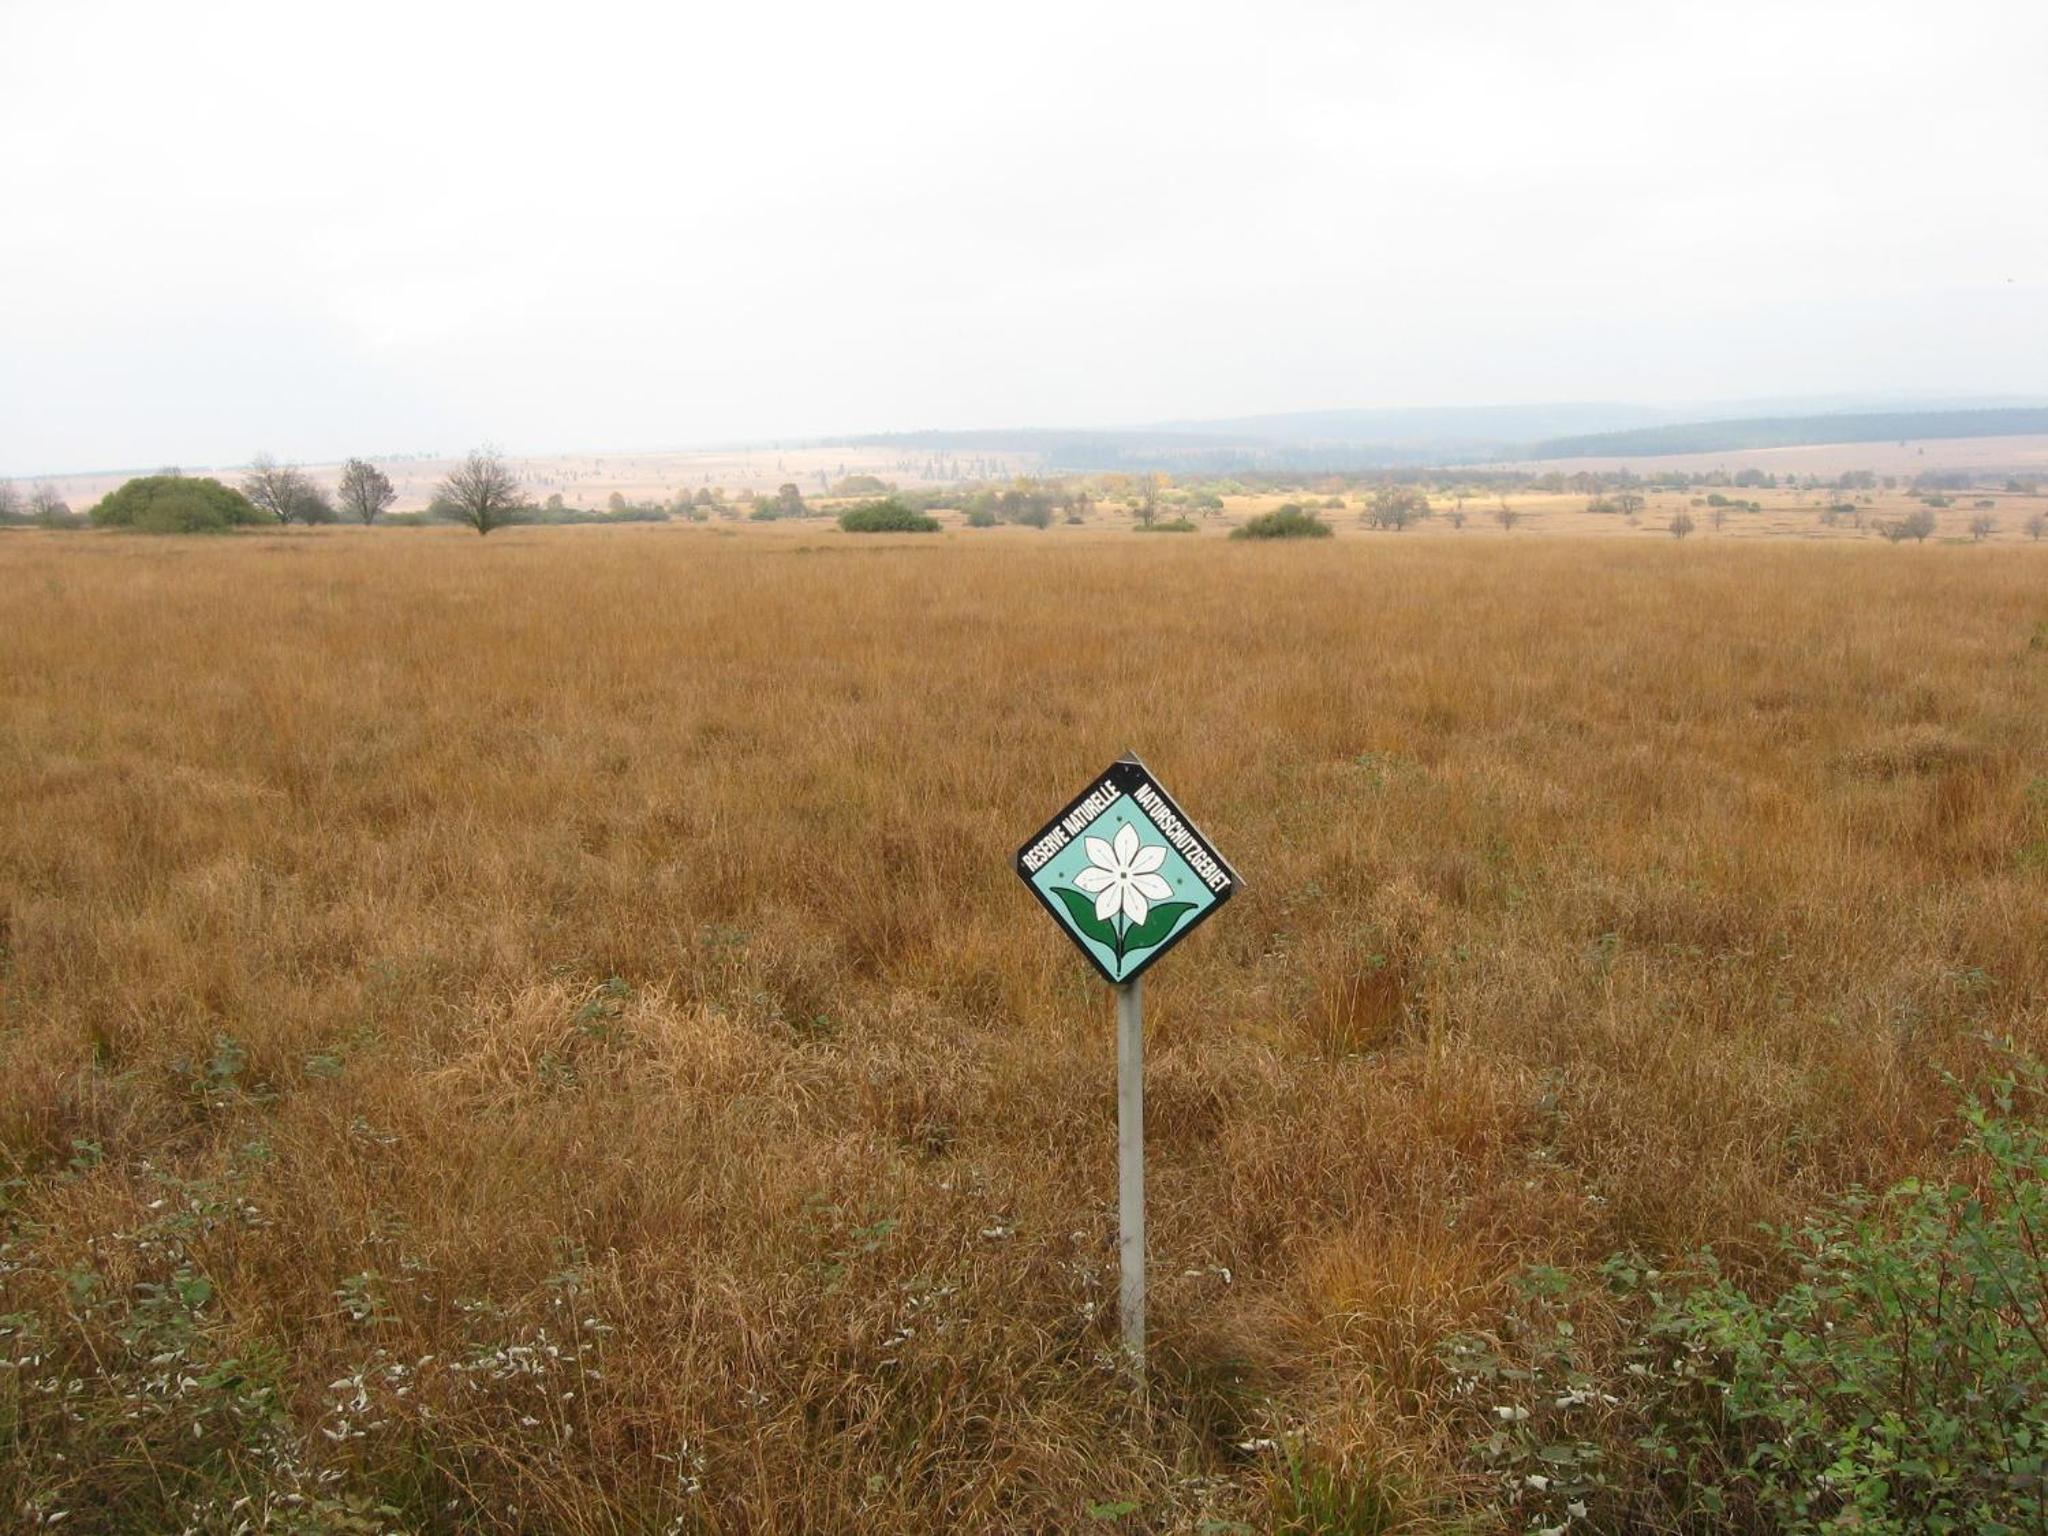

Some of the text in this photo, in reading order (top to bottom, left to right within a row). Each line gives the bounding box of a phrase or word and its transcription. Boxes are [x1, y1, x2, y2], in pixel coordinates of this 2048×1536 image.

[1022, 780, 1121, 872] RESERVE NATURELLE
[1134, 783, 1231, 893] NATURSCHUTZGEBIET
